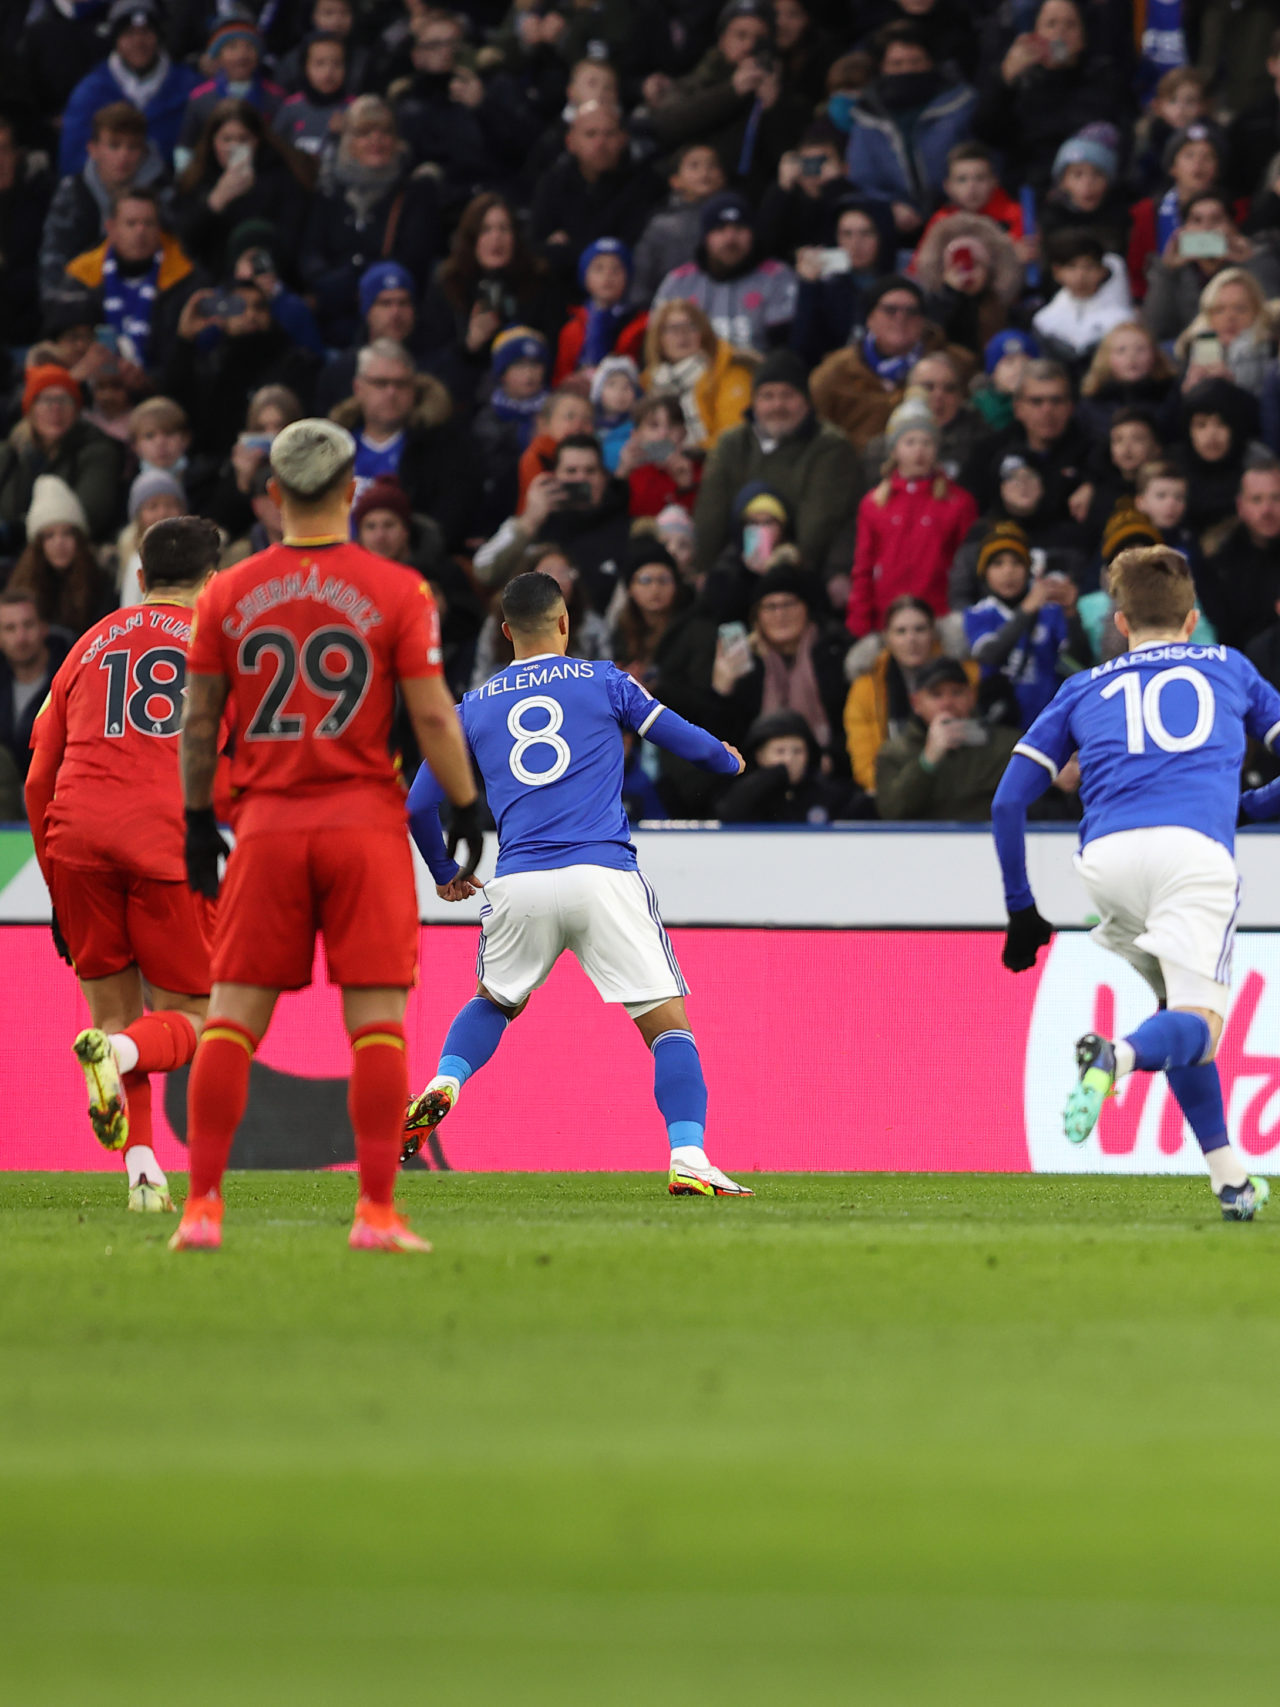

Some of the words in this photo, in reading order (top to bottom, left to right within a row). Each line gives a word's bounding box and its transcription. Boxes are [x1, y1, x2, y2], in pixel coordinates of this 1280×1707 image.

[80, 611, 143, 664] OZAN
[149, 610, 193, 642] TUF
[478, 663, 594, 700] TIELEMANS
[99, 646, 187, 738] 18
[237, 624, 374, 742] 29
[1099, 665, 1216, 754] 10
[507, 695, 571, 786] 8
